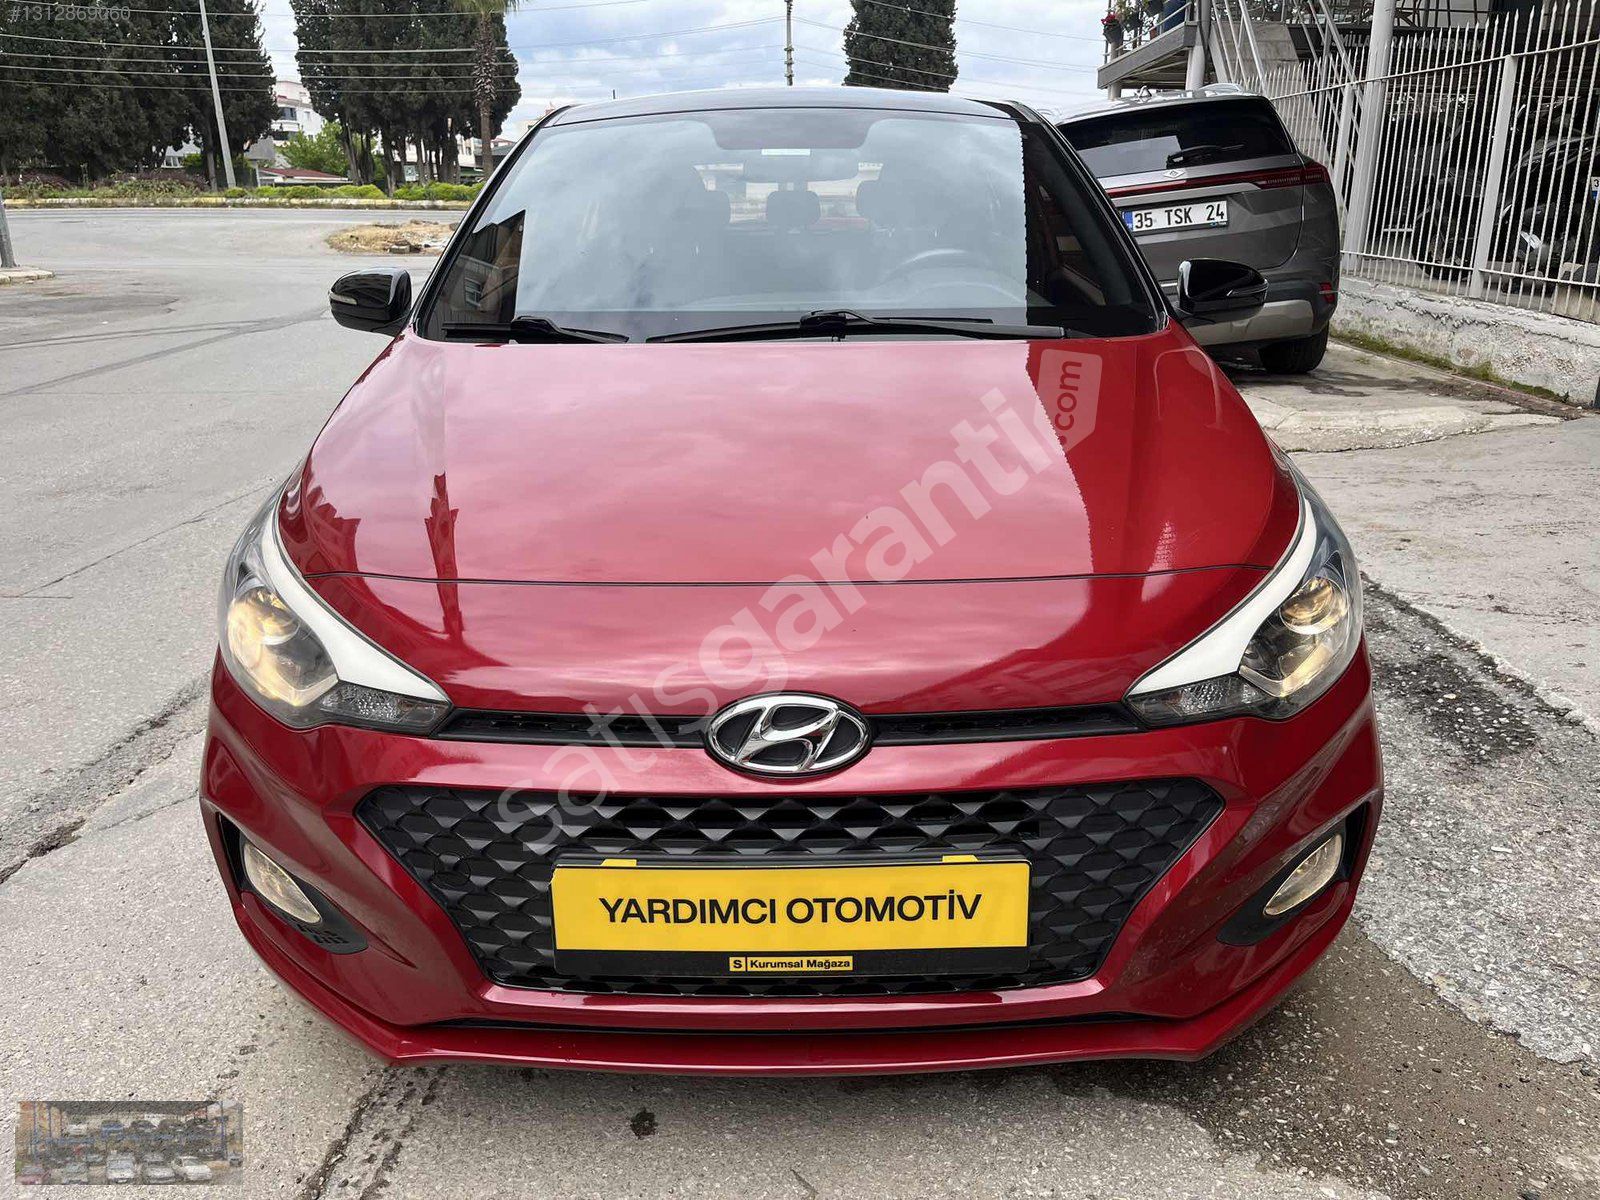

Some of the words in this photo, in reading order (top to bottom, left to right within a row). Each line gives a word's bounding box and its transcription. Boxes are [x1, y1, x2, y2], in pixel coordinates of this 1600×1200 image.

[1134, 211, 1153, 229] 35
[1164, 206, 1193, 226] TSK
[1205, 203, 1225, 221] 24
[599, 898, 776, 924] YARDIMCI
[785, 888, 983, 924] OTOMOTİV
[750, 959, 804, 969] Kurumsal
[806, 959, 851, 970] Mağaza
